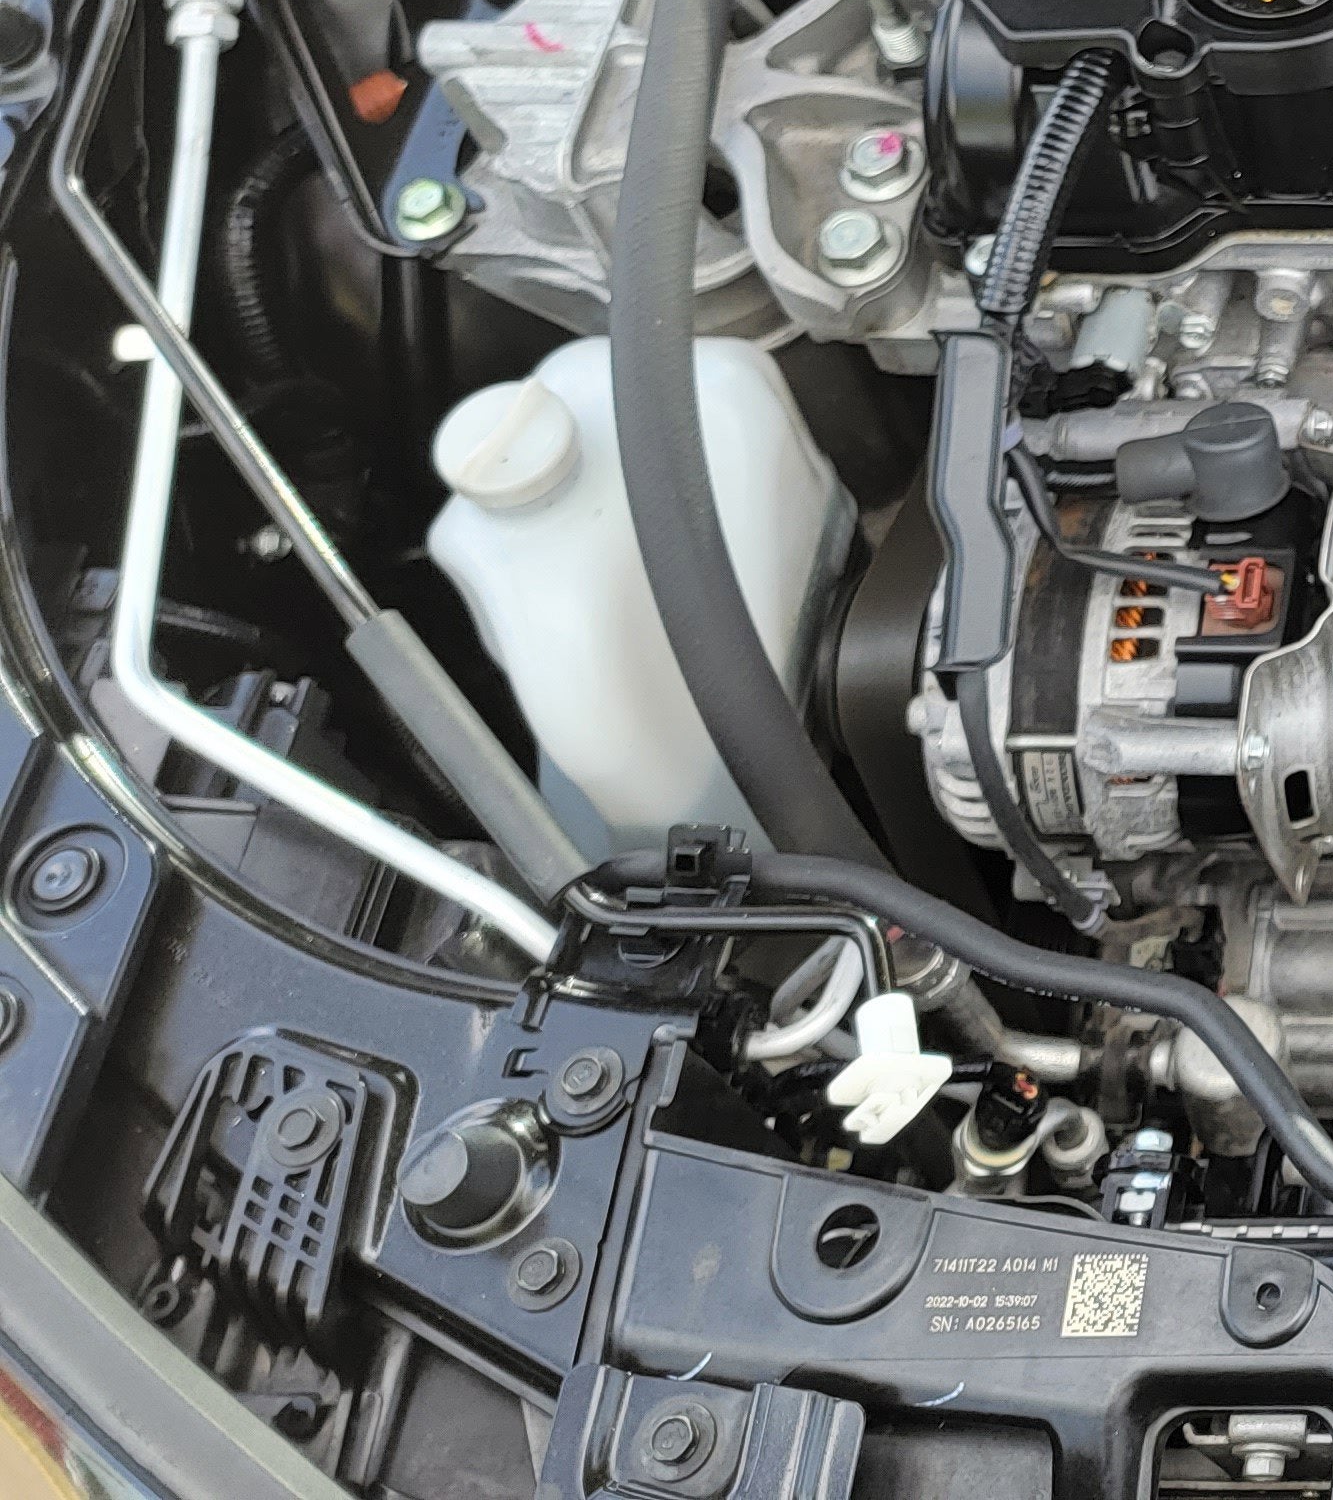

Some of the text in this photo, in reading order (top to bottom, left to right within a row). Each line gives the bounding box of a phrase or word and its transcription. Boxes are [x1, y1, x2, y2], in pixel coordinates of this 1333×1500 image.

[1002, 1257, 1037, 1273] A014
[1042, 1257, 1059, 1272] M1
[925, 1294, 1038, 1308] 2022-10-02 15:39:07
[929, 1315, 1041, 1333] SN: A0265165
